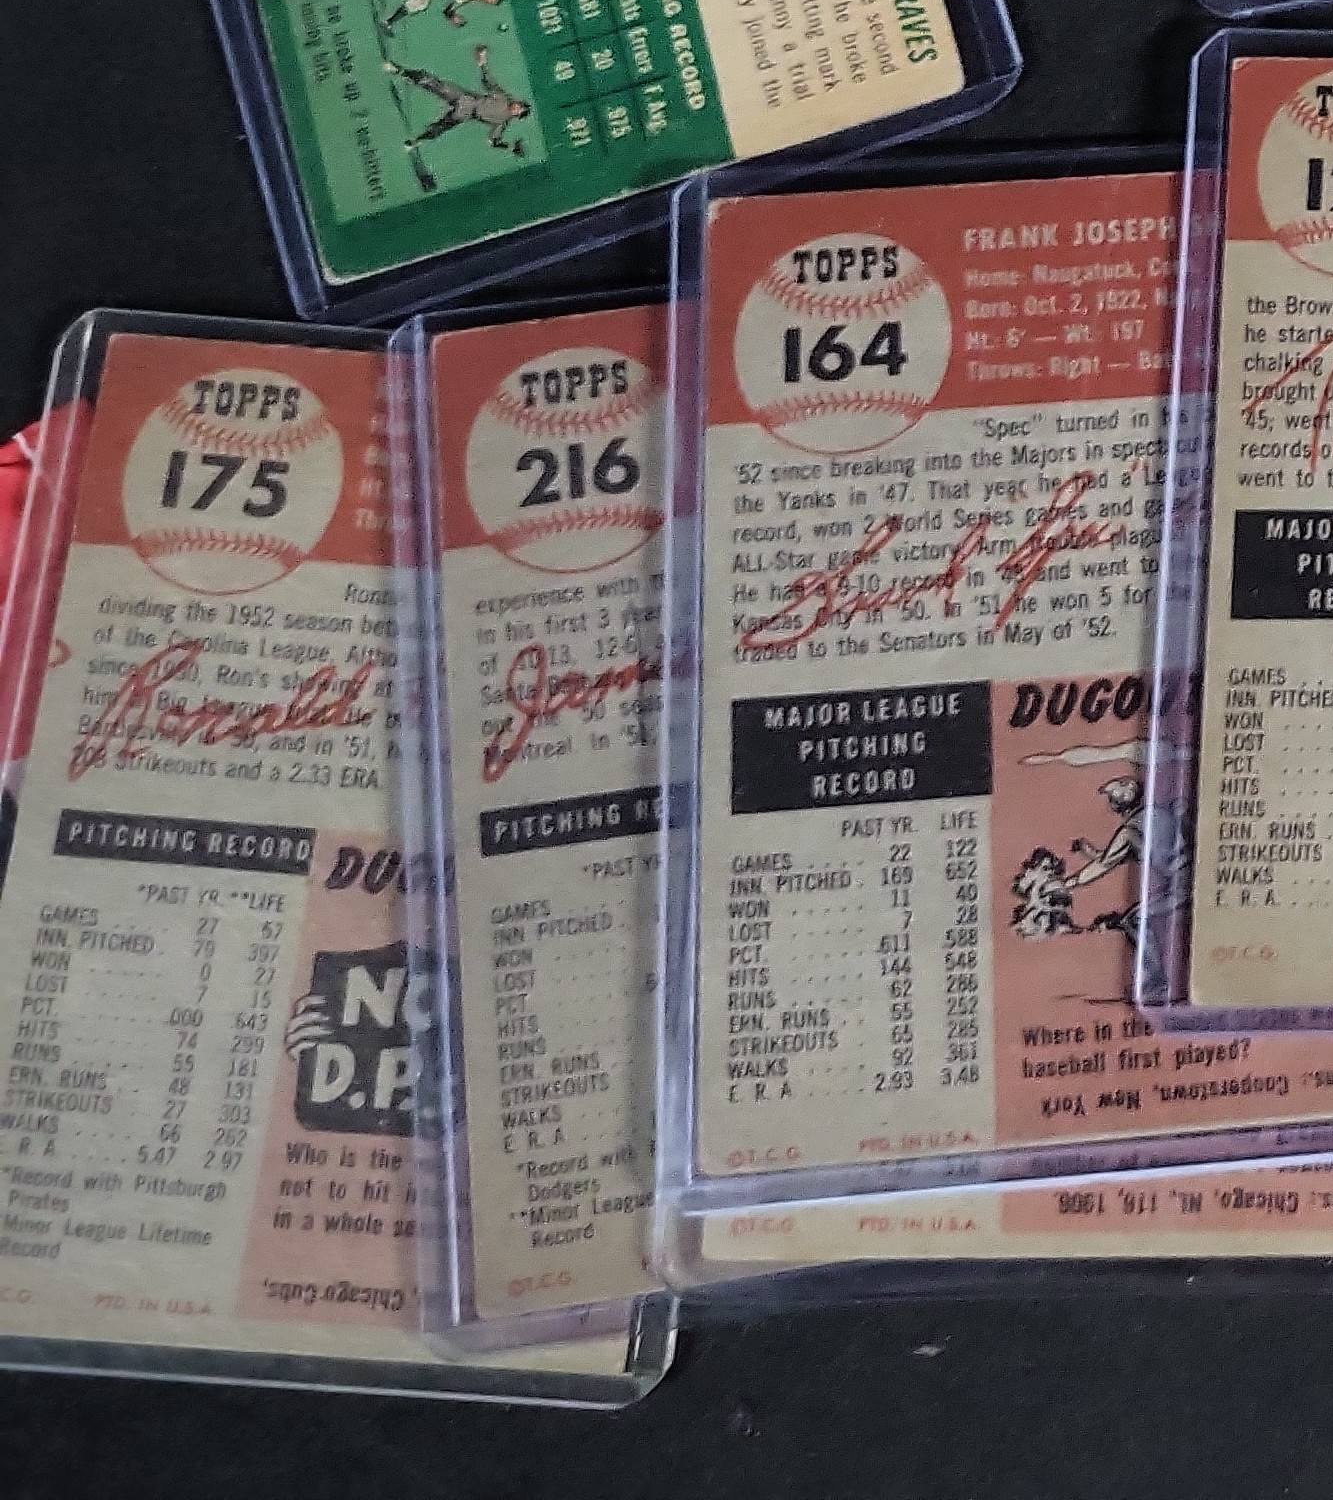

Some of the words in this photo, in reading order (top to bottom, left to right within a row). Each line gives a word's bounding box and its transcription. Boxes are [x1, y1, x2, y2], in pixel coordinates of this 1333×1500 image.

[964, 224, 1059, 251] FRANK
[1074, 216, 1179, 246] JOSEPH
[794, 245, 899, 286] TOPPS
[784, 321, 908, 382] 164
[192, 380, 301, 419] TOPPS
[520, 360, 628, 405] TOPPS
[162, 450, 289, 518] 175
[518, 438, 641, 506] 216
[765, 704, 851, 731] MAJOR
[863, 693, 961, 723] LEAGUE
[799, 734, 927, 762] PITCHING
[812, 768, 916, 798] RECORD
[68, 821, 194, 854] PITCHING
[206, 830, 312, 861] RECORD
[1218, 844, 1323, 864] STRIKEOUTS
